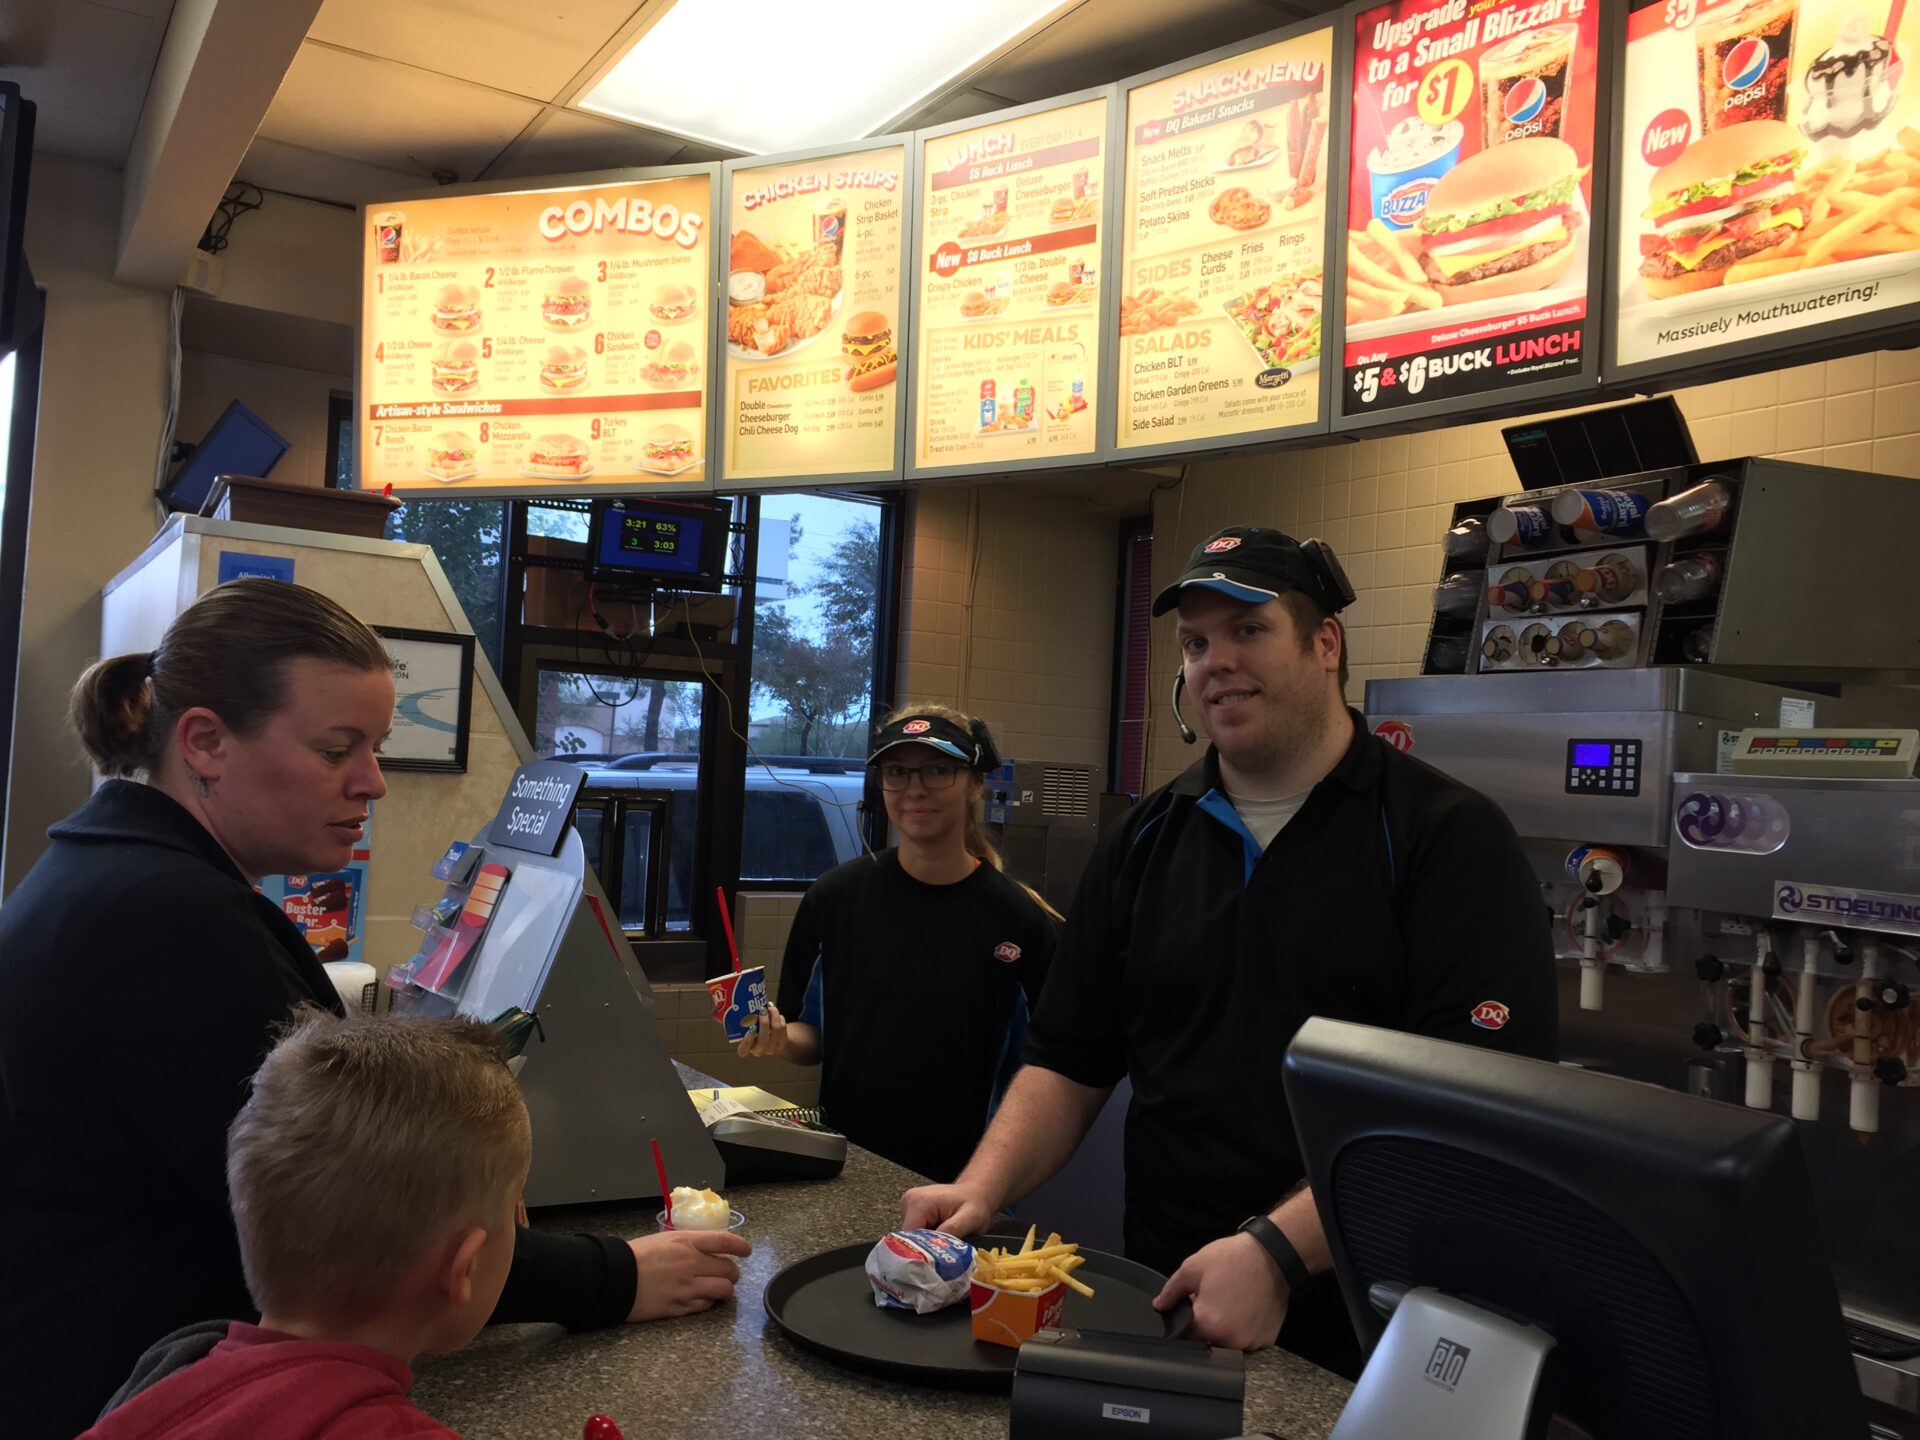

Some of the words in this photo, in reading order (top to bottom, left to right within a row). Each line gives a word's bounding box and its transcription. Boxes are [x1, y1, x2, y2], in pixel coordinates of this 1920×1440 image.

[1373, 0, 1467, 51] Upgrade
[1469, 0, 1496, 17] your
[1664, 0, 1697, 30] $5
[1368, 57, 1391, 83] to
[1395, 56, 1410, 73] a
[1413, 18, 1480, 67] Small
[1173, 68, 1251, 113] SNACK
[1250, 60, 1325, 90] MENU
[1381, 80, 1420, 112] for
[1426, 64, 1460, 117] $1
[1724, 83, 1766, 112] pepsi
[1143, 124, 1161, 139] New
[1166, 120, 1180, 135] DQ
[1181, 109, 1216, 129] Bakes!
[1218, 98, 1255, 119] Snacks
[1505, 119, 1544, 142] pepsi
[1645, 122, 1688, 155] New
[943, 131, 1015, 173] LUNCH
[1020, 135, 1046, 151] EVERY
[1046, 132, 1063, 146] DAY
[1141, 152, 1167, 167] Snack
[1168, 145, 1192, 160] Melts
[981, 162, 1004, 178] Buck
[1005, 156, 1034, 173] Lunch
[743, 171, 830, 211] CHICKEN
[834, 168, 898, 192] STRIPS
[1015, 181, 1072, 201] Cheeseburger
[1016, 174, 1043, 188] Deluxe
[1140, 189, 1157, 203] Soft
[1158, 181, 1189, 198] Pretzel
[1190, 175, 1216, 191] Sticks
[864, 198, 892, 212] Chicken
[950, 187, 981, 202] Chicken
[1382, 189, 1429, 215] BLIZZA
[538, 196, 703, 250] COMBOS
[856, 213, 874, 226] Strip
[874, 208, 899, 222] Basket
[930, 206, 949, 219] Strip
[1139, 215, 1166, 229] Potato
[1167, 209, 1191, 224] Skins
[967, 250, 979, 264] $6
[979, 246, 1003, 261] Buck
[1003, 240, 1032, 257] Lunch
[1201, 249, 1234, 265] Cheese
[1241, 241, 1265, 256] Fries
[1279, 232, 1305, 248] Rings
[597, 260, 608, 283] 3
[609, 259, 621, 270] 1/4
[621, 258, 632, 269] lb.
[632, 256, 671, 269] Mushroom
[671, 254, 692, 264] Swiss
[935, 251, 962, 270] New
[1014, 262, 1026, 273] 1/3
[1027, 260, 1038, 272] lb.
[1039, 255, 1067, 269] Double
[1137, 258, 1192, 286] SIDES
[1200, 262, 1227, 277] Curds
[376, 272, 384, 294] 1
[399, 270, 409, 281] lb.
[409, 270, 431, 280] Bacon
[431, 270, 458, 279] Cheese
[484, 266, 495, 289] 2
[499, 267, 510, 276] 1/2
[510, 266, 521, 276] lb.
[521, 264, 576, 275] FlameThrower
[928, 282, 952, 294] Crispy
[952, 276, 982, 289] Chicken
[1019, 271, 1048, 284] Cheese
[1431, 330, 1459, 344] Deluxe
[1459, 316, 1516, 338] Cheeseburger
[1517, 314, 1528, 326] $5
[1529, 310, 1552, 323] Buck
[1552, 304, 1581, 318] Lunch
[1656, 317, 1732, 345] Massively
[1736, 282, 1880, 328] Mouthwatering!
[482, 336, 493, 359] 5
[496, 336, 507, 346] 1/4
[508, 335, 519, 346] lb.
[518, 335, 546, 345] Cheese
[594, 332, 605, 355] 6
[606, 329, 634, 341] Chicken
[606, 341, 641, 352] Sandwich
[963, 331, 1010, 351] KIDS'
[1012, 324, 1079, 346] MEALS
[1134, 328, 1212, 356] SALADS
[375, 341, 385, 363] 4
[387, 341, 398, 351] 1/2
[398, 340, 408, 350] lb.
[407, 339, 433, 350] Cheese
[1357, 354, 1371, 366] On
[1371, 351, 1389, 363] Any
[1134, 359, 1166, 375] Chicken
[1167, 355, 1184, 370] BLT
[1353, 367, 1381, 403] $5
[1380, 367, 1397, 387] &
[1399, 355, 1428, 395] $6
[1428, 348, 1492, 378] BUCK
[1496, 330, 1581, 365] LUNCH
[748, 367, 842, 394] FAVORITES
[1258, 369, 1290, 387] Marzetti
[1133, 387, 1165, 403] Chicken
[1166, 381, 1197, 398] Garden
[1199, 378, 1230, 392] Greens
[375, 403, 441, 418] Artisan-style
[442, 401, 502, 415] Sandwiches
[740, 400, 766, 411] Double
[591, 418, 601, 440] 9
[603, 417, 628, 428] Turkey
[739, 412, 791, 424] Cheeseburger
[1132, 417, 1150, 431] Side
[1152, 414, 1175, 428] Salad
[374, 425, 384, 447] 7
[385, 424, 412, 434] Chicken
[411, 423, 433, 433] Bacon
[385, 435, 406, 445] Ranch
[479, 421, 490, 443] 8
[492, 420, 521, 430] Chicken
[492, 431, 532, 442] Mozzarella
[602, 428, 617, 438] BLT
[739, 425, 756, 437] Chili
[756, 424, 783, 435] Cheese
[784, 423, 799, 435] Dog
[625, 518, 647, 529] 3:21
[655, 522, 677, 533] 63%
[631, 537, 638, 546] 3
[654, 540, 675, 550] 3:03
[511, 773, 572, 809] Something
[506, 805, 551, 836] Special
[285, 902, 327, 915] Buster
[998, 945, 1018, 961] DQ
[1480, 1006, 1505, 1023] DQ
[1111, 1407, 1141, 1419] EPSON
